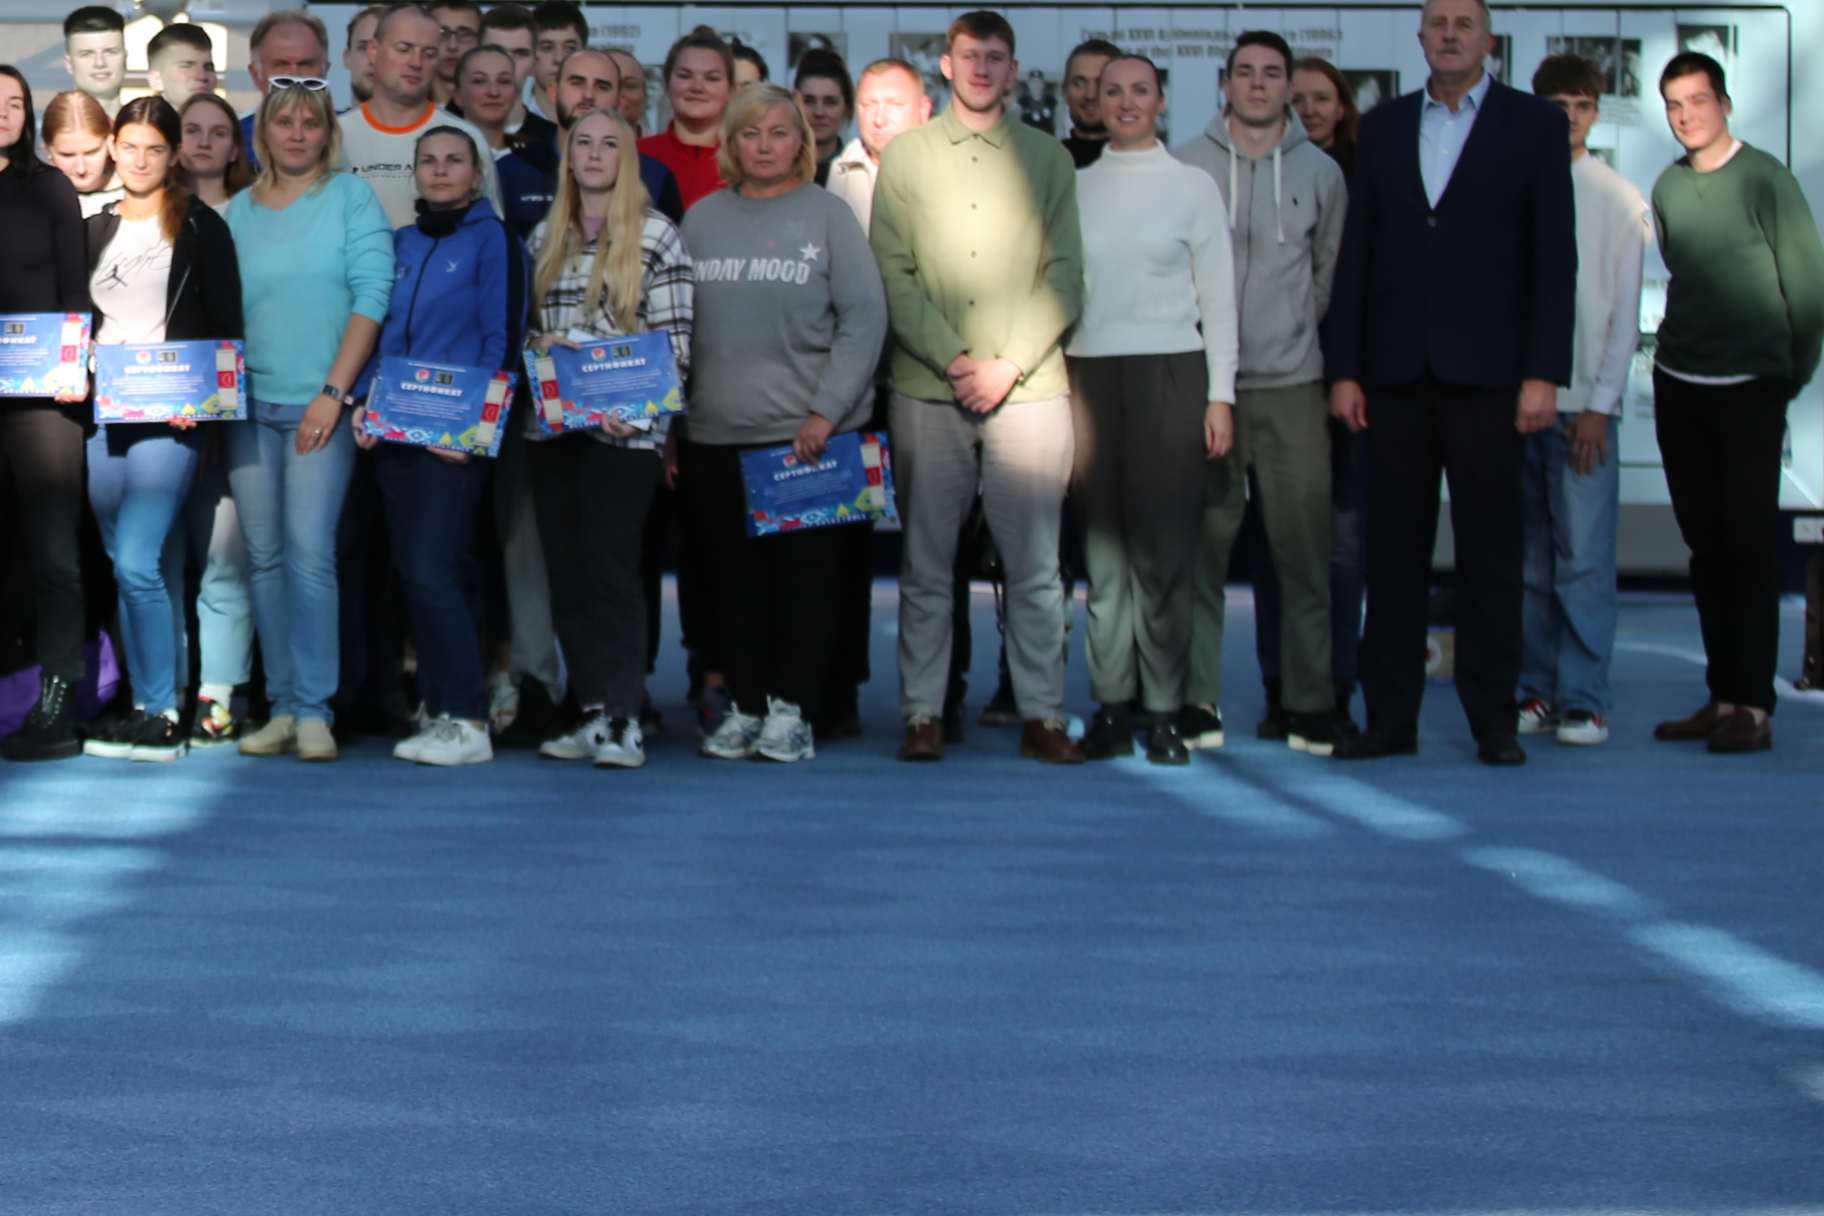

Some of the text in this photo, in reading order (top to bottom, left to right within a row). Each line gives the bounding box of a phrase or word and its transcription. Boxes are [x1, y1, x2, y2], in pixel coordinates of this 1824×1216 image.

[361, 163, 414, 174] UNDER A
[692, 258, 811, 286] NDAY MOOD
